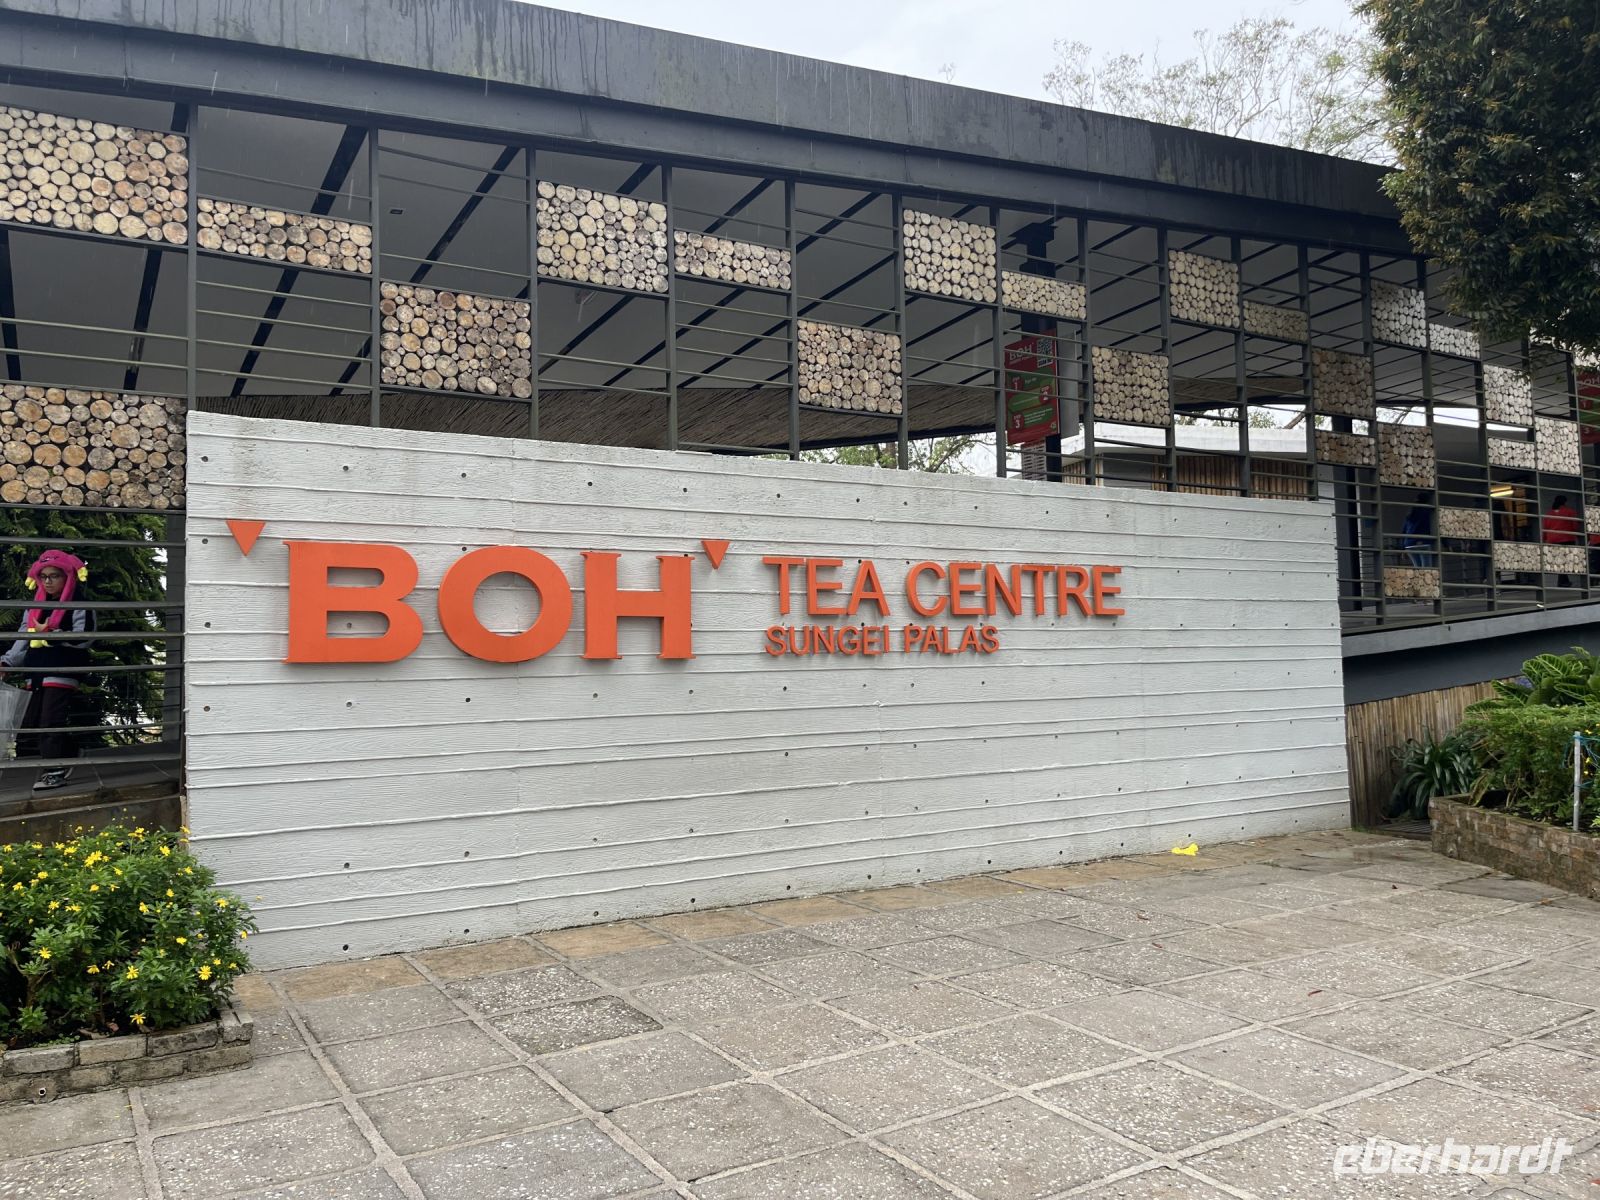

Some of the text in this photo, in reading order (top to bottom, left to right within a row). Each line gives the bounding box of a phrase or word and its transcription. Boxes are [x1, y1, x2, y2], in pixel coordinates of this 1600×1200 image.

[1015, 419, 1021, 429] 3
[282, 541, 697, 664] BOH
[762, 556, 1126, 617] TEA CENTRE
[765, 624, 1000, 657] SUNGEI PALAS
